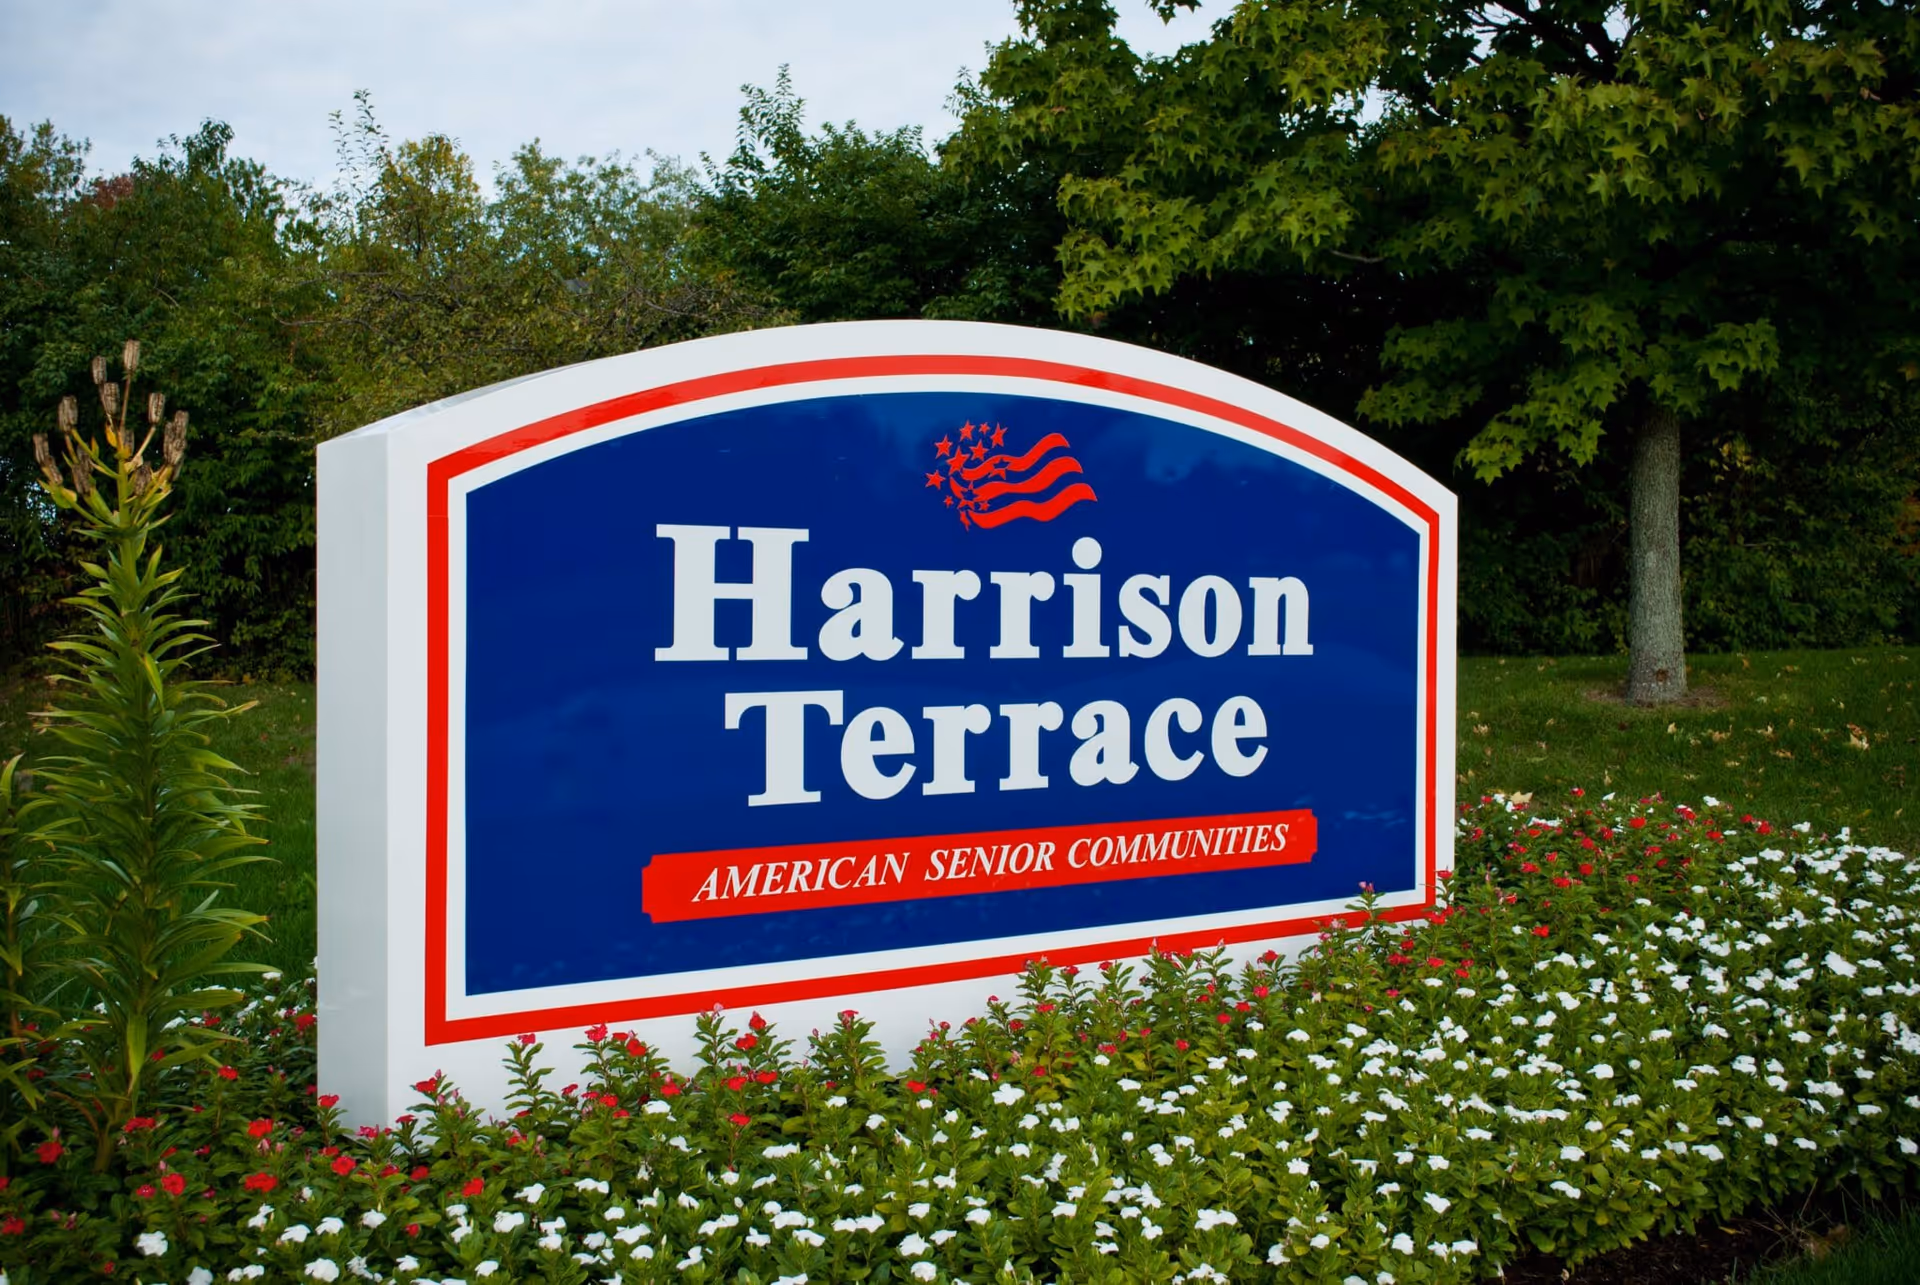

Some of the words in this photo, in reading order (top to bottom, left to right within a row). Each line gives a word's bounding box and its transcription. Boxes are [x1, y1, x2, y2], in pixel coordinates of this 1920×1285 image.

[654, 524, 1314, 661] Harrison
[724, 690, 1268, 807] Terrace
[691, 852, 909, 903] AMERICAN
[924, 841, 1056, 881] SENIOR
[1067, 823, 1289, 869] COMMUNITIES
